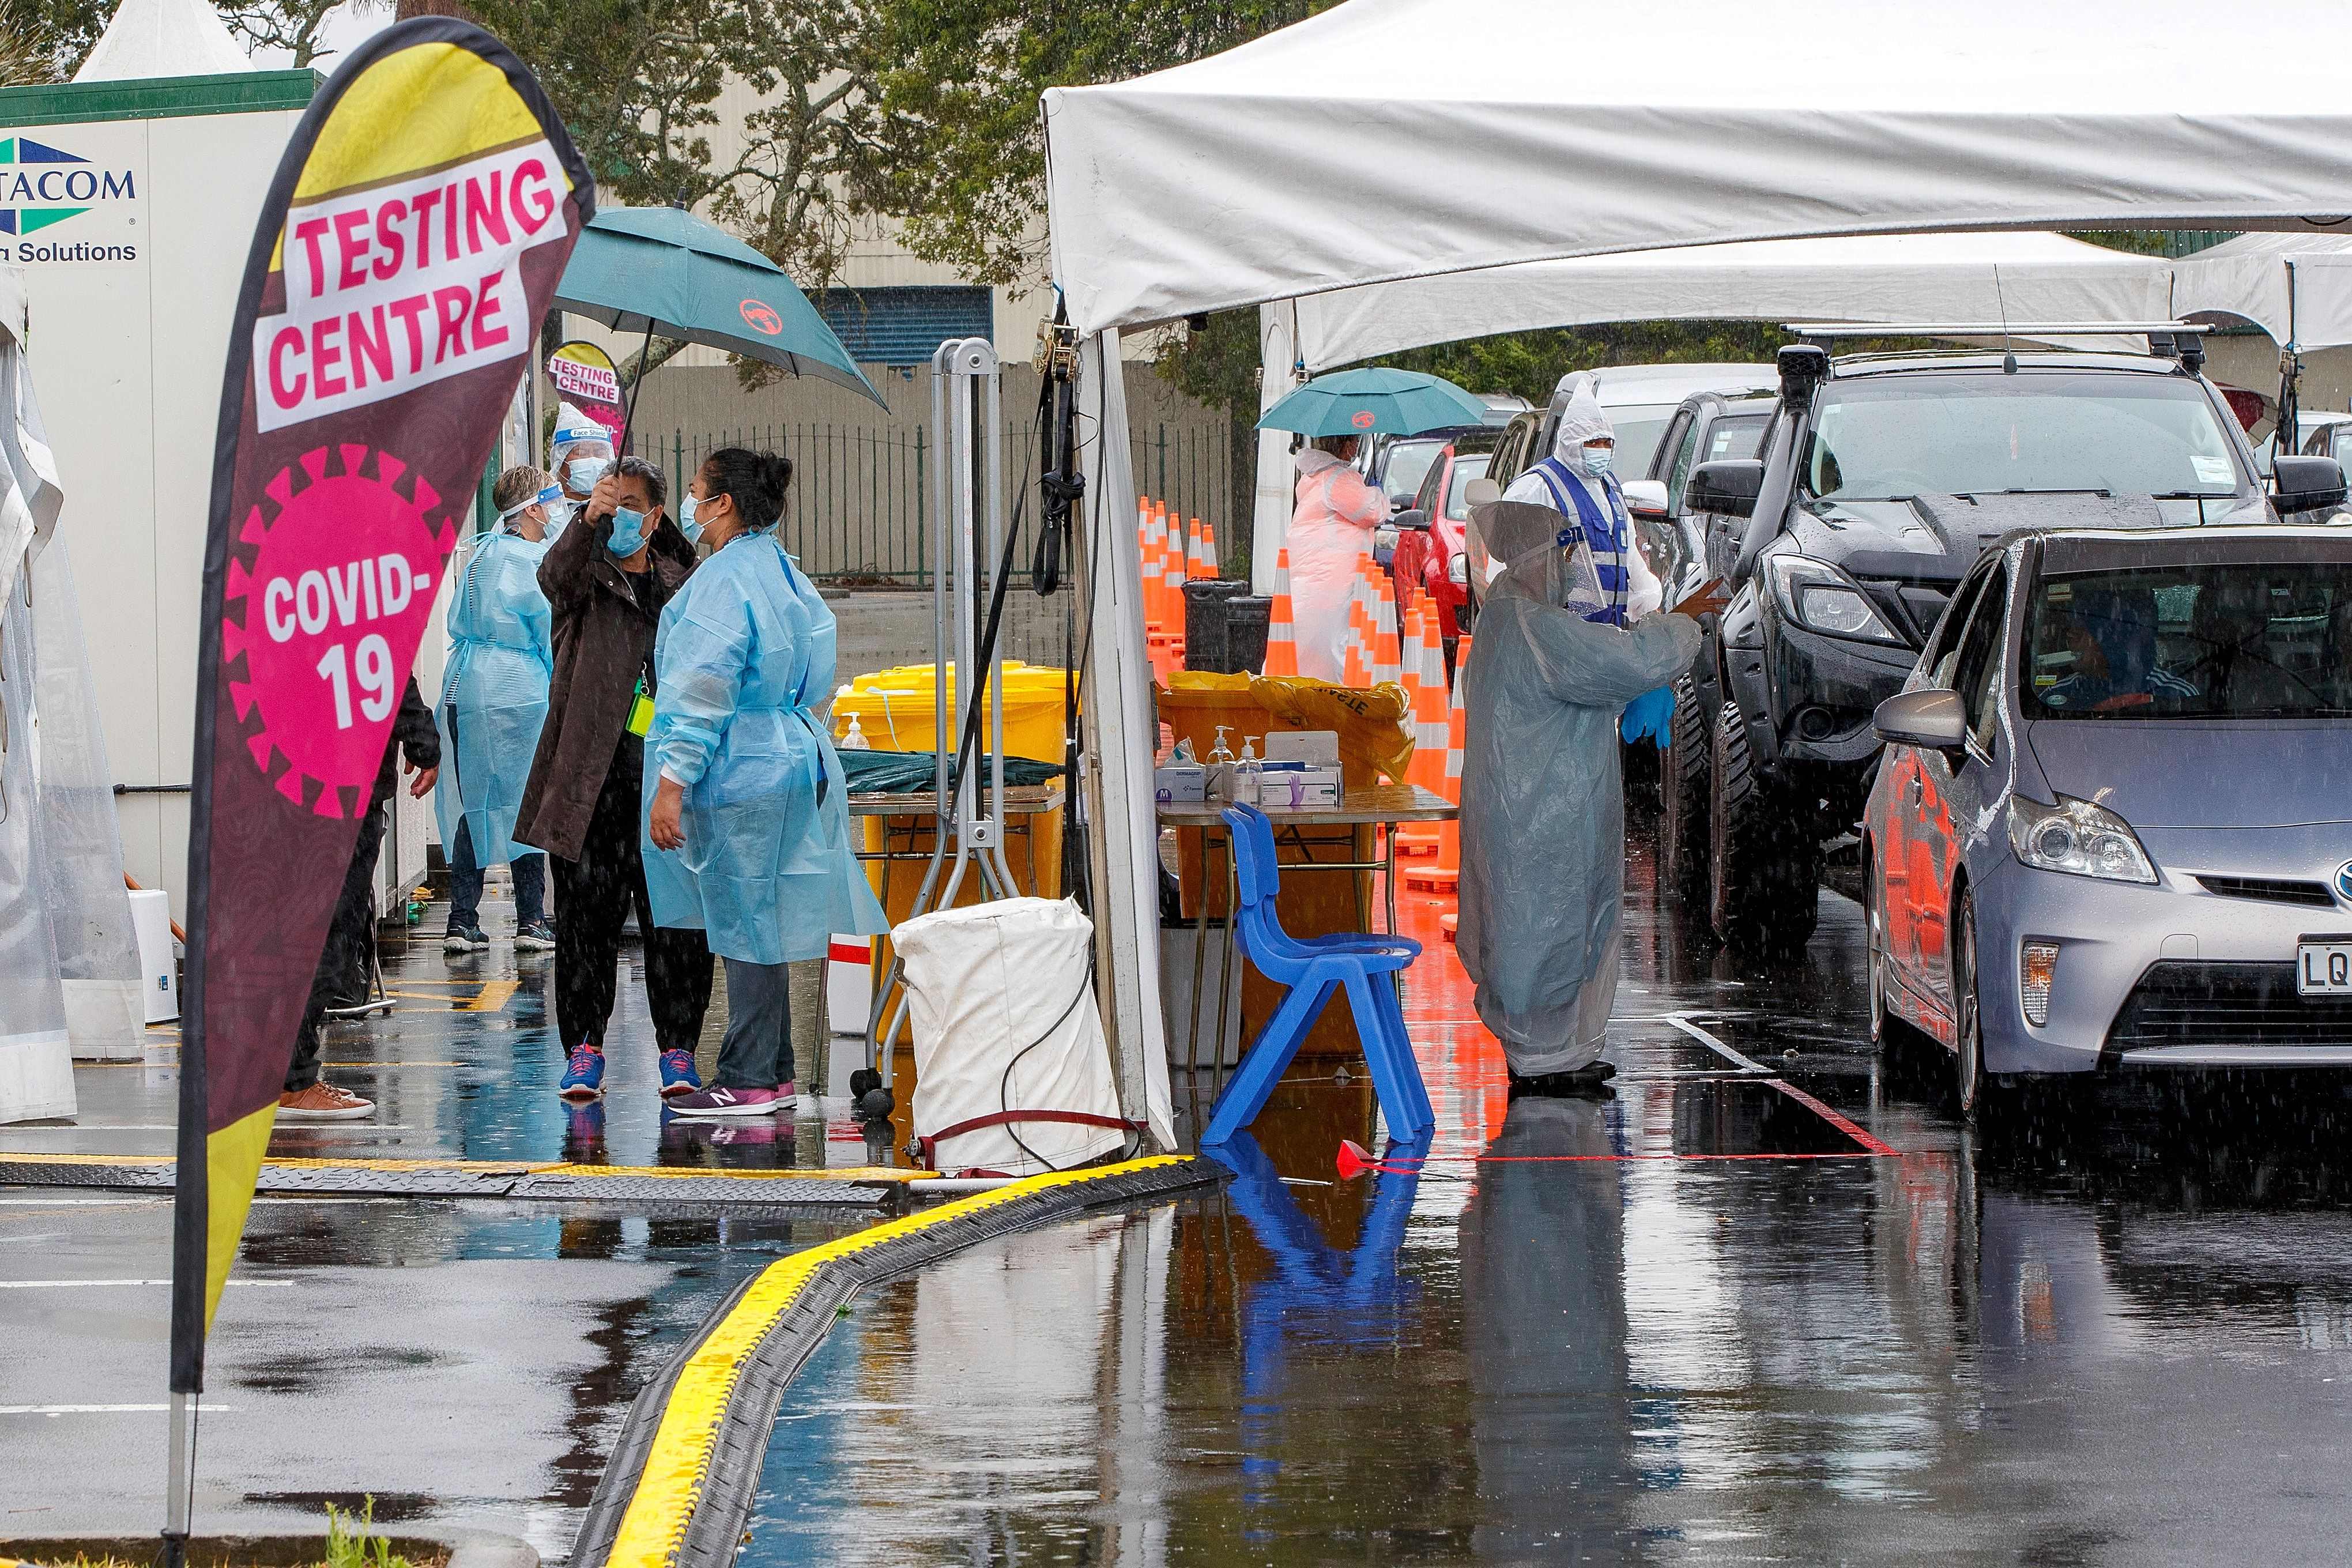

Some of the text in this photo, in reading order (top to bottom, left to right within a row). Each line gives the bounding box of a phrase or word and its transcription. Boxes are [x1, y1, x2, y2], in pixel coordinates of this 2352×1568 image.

[295, 159, 555, 299] TESTING
[18, 242, 136, 262] Solutions
[269, 269, 509, 410] CENTRE
[553, 359, 612, 384] TESTING
[559, 376, 615, 400] CENTRE
[589, 429, 606, 437] Shield
[264, 553, 430, 643] COVID-
[316, 634, 395, 730] 19
[1160, 790, 1169, 798] M
[2305, 952, 2352, 986] LQ
